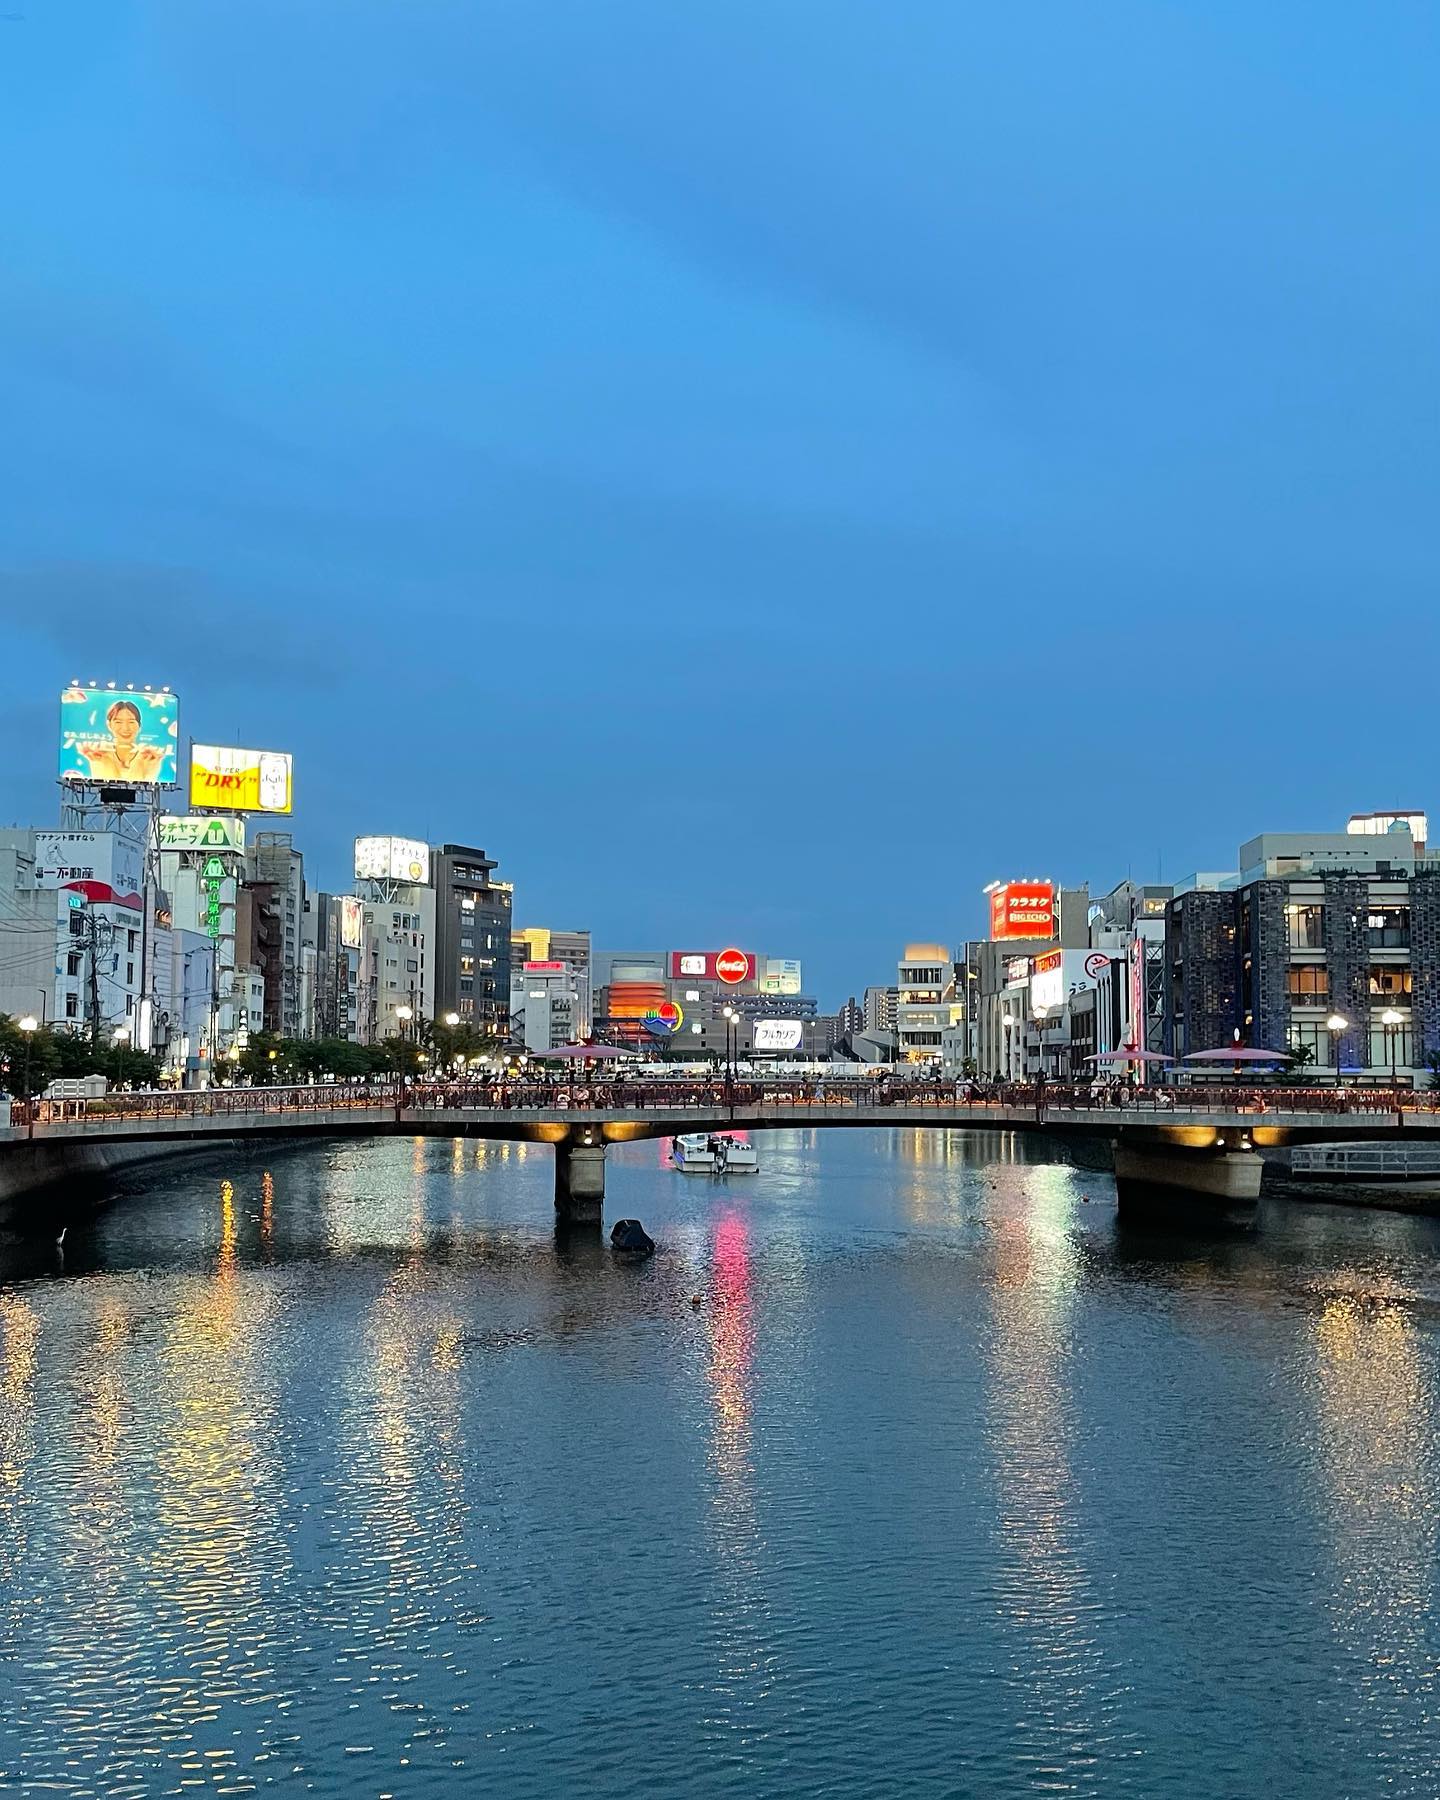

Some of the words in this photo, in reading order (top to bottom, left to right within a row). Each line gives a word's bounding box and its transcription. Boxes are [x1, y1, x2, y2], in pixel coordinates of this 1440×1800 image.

[1009, 897, 1050, 907] カラオケ
[1009, 913, 1026, 922] BIG
[1026, 913, 1051, 922] ECHO
